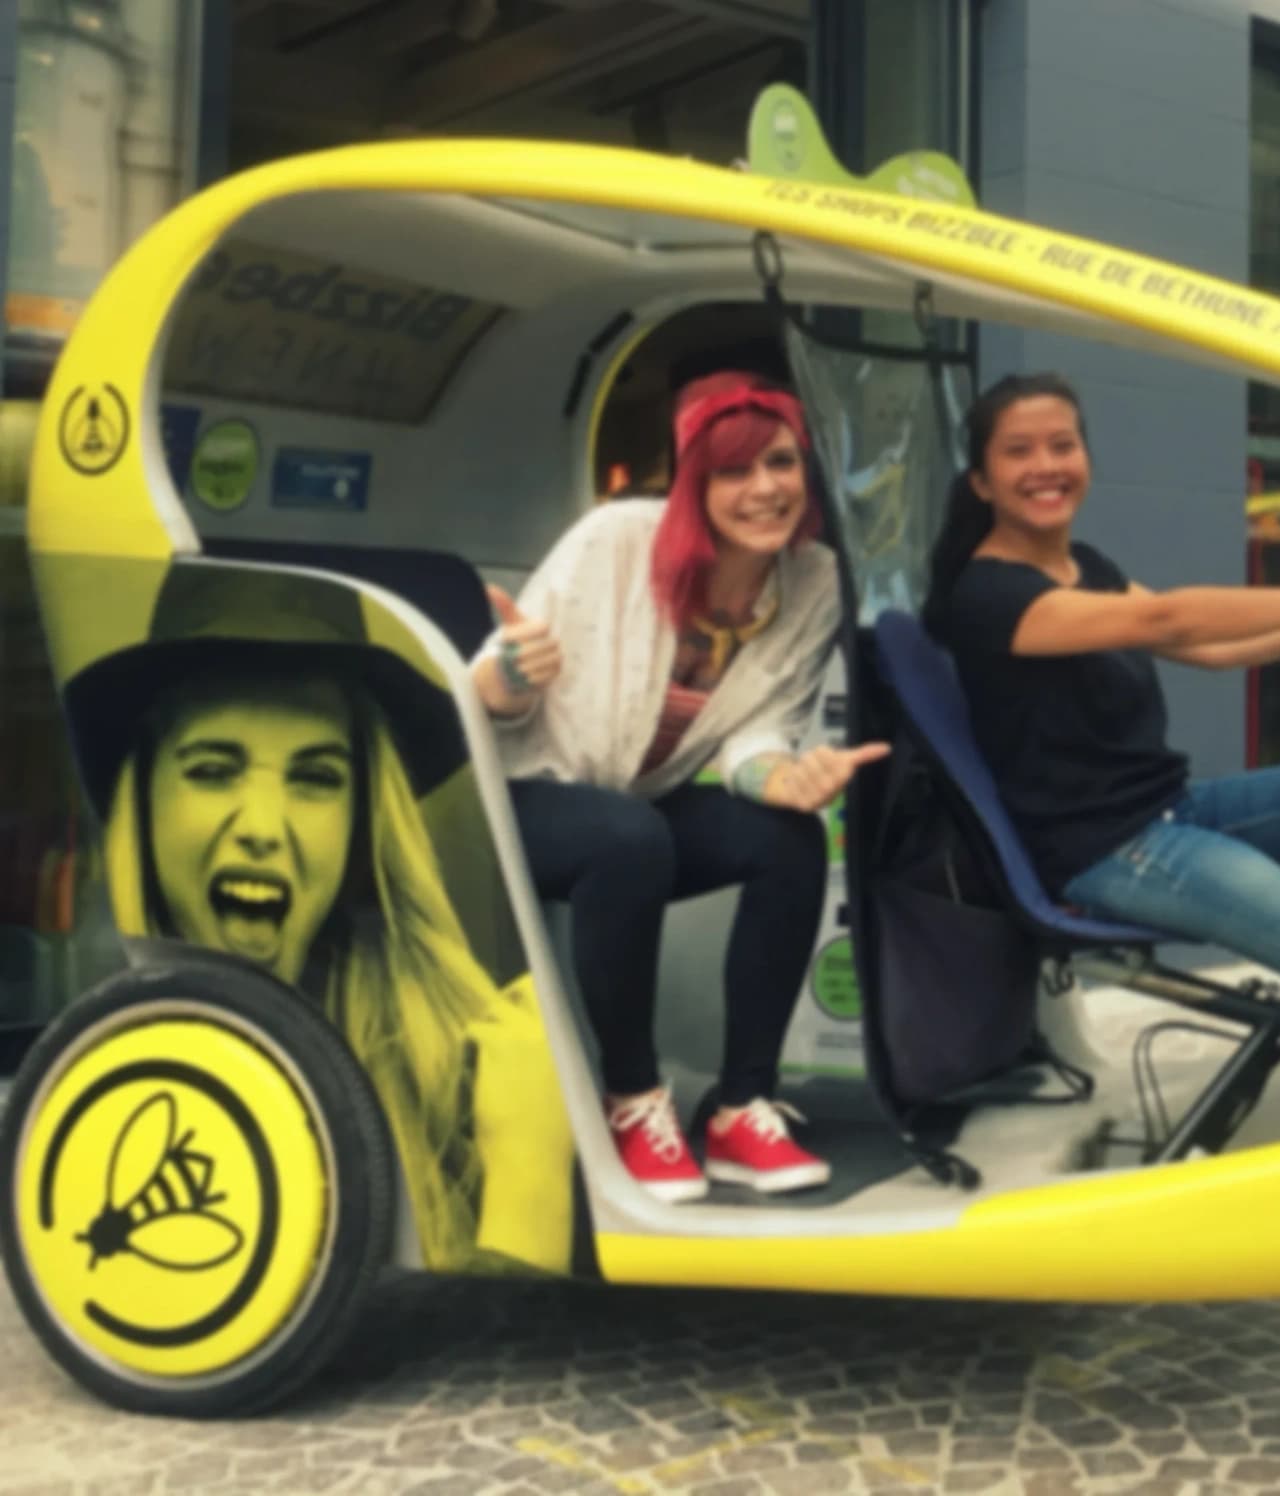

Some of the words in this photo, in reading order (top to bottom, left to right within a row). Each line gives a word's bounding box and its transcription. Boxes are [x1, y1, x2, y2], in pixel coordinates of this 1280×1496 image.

[906, 210, 1019, 254] BIZZBEE
[1040, 242, 1094, 277] RUE
[1098, 259, 1137, 288] DE
